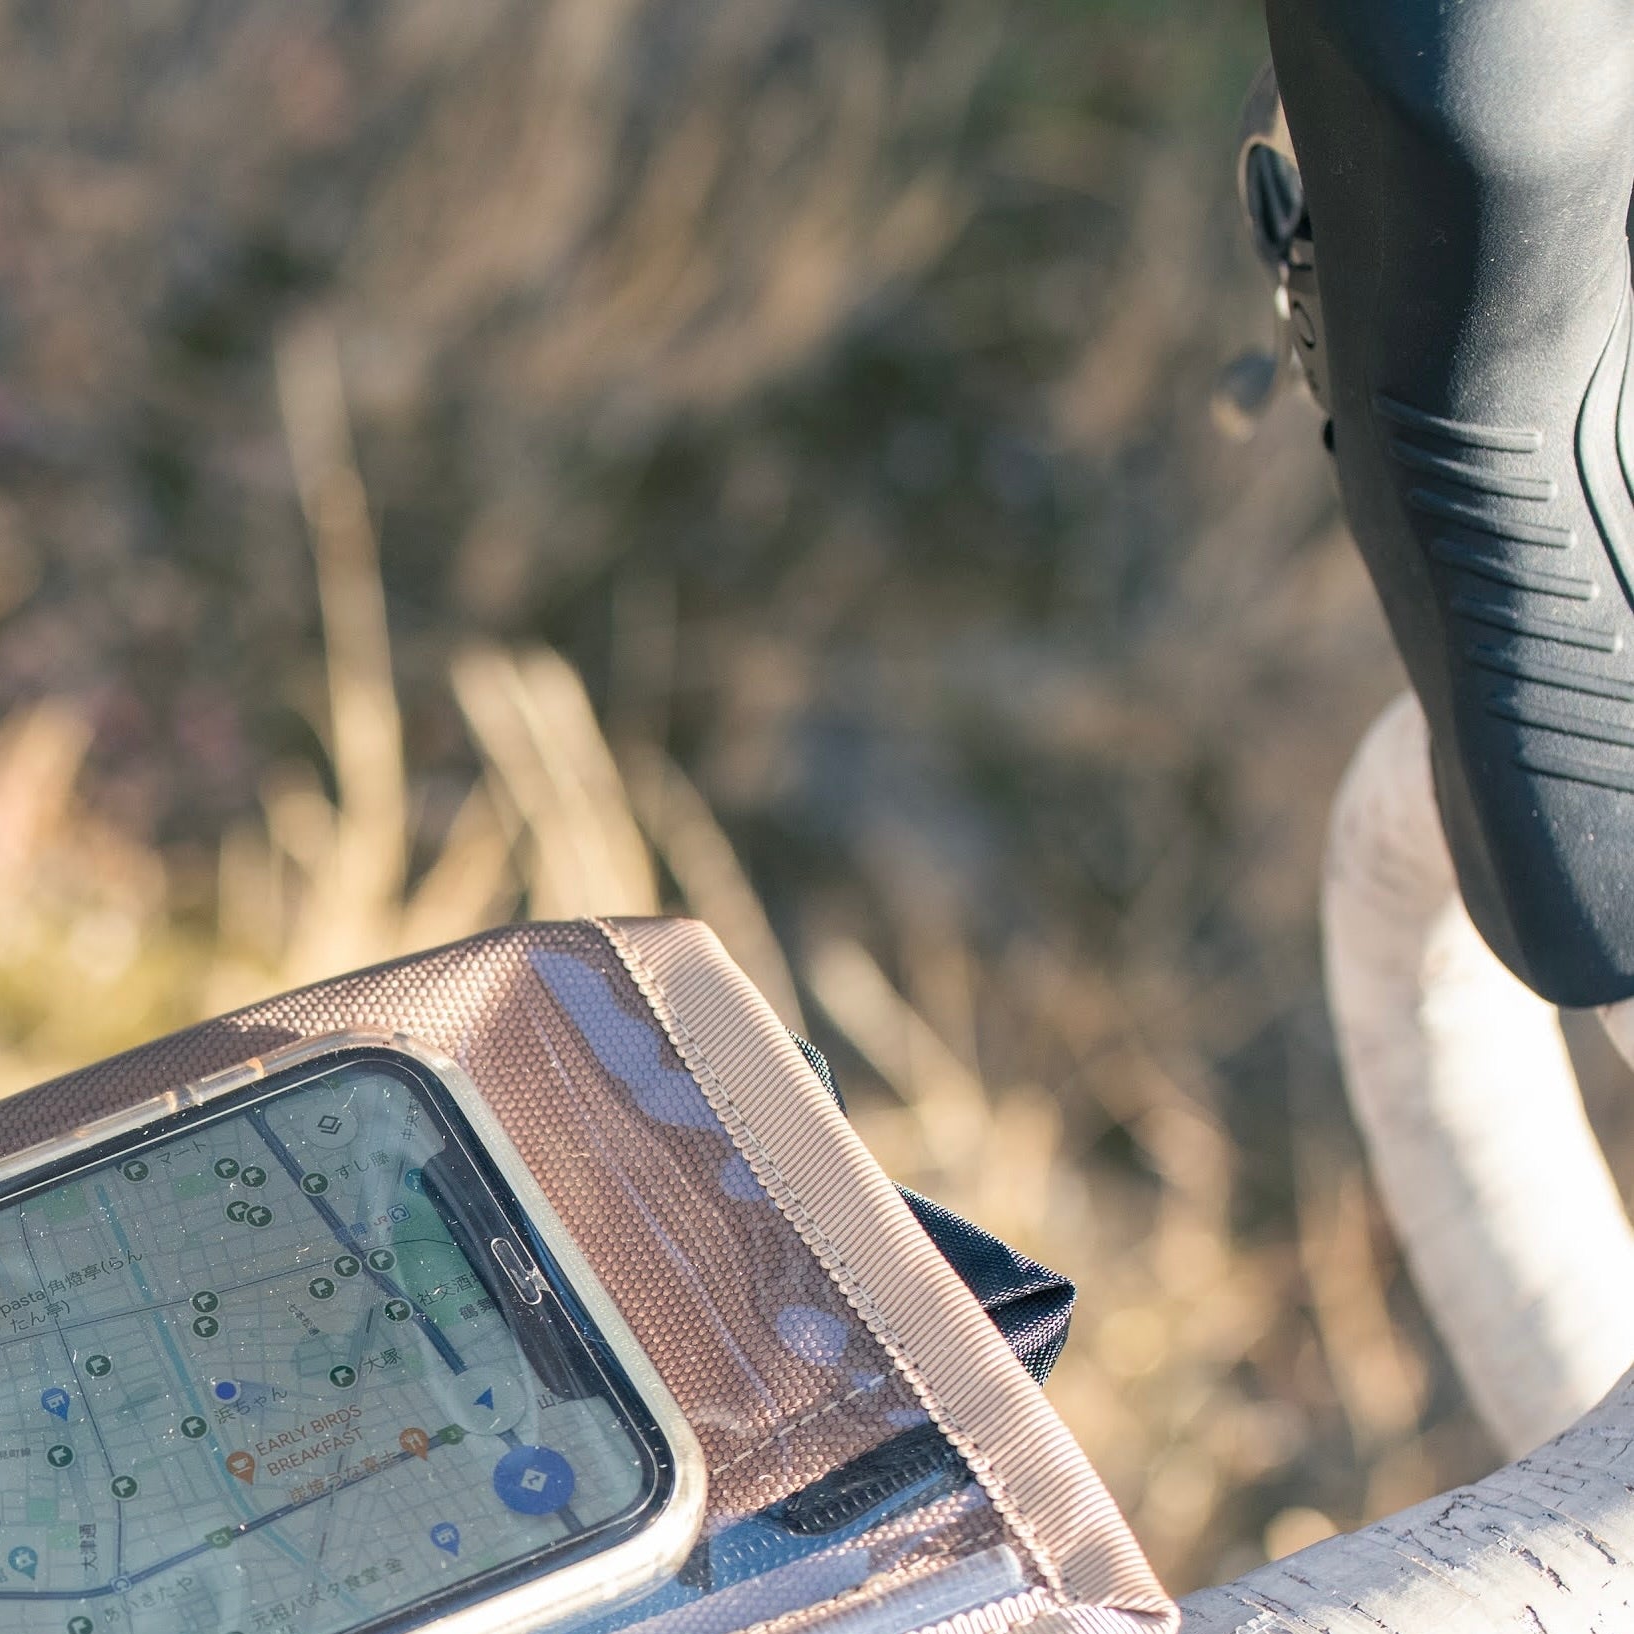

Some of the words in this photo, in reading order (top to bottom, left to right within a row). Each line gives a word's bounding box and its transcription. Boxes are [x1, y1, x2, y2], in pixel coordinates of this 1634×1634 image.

[156, 1137, 208, 1167] マート
[335, 1148, 391, 1181] すし藤
[362, 1346, 403, 1374] 大塚
[212, 1383, 290, 1425] 浜ちゃん
[255, 1425, 310, 1456] EARLY
[311, 1403, 363, 1433] BIRDS
[266, 1426, 365, 1475] BREAKFAST
